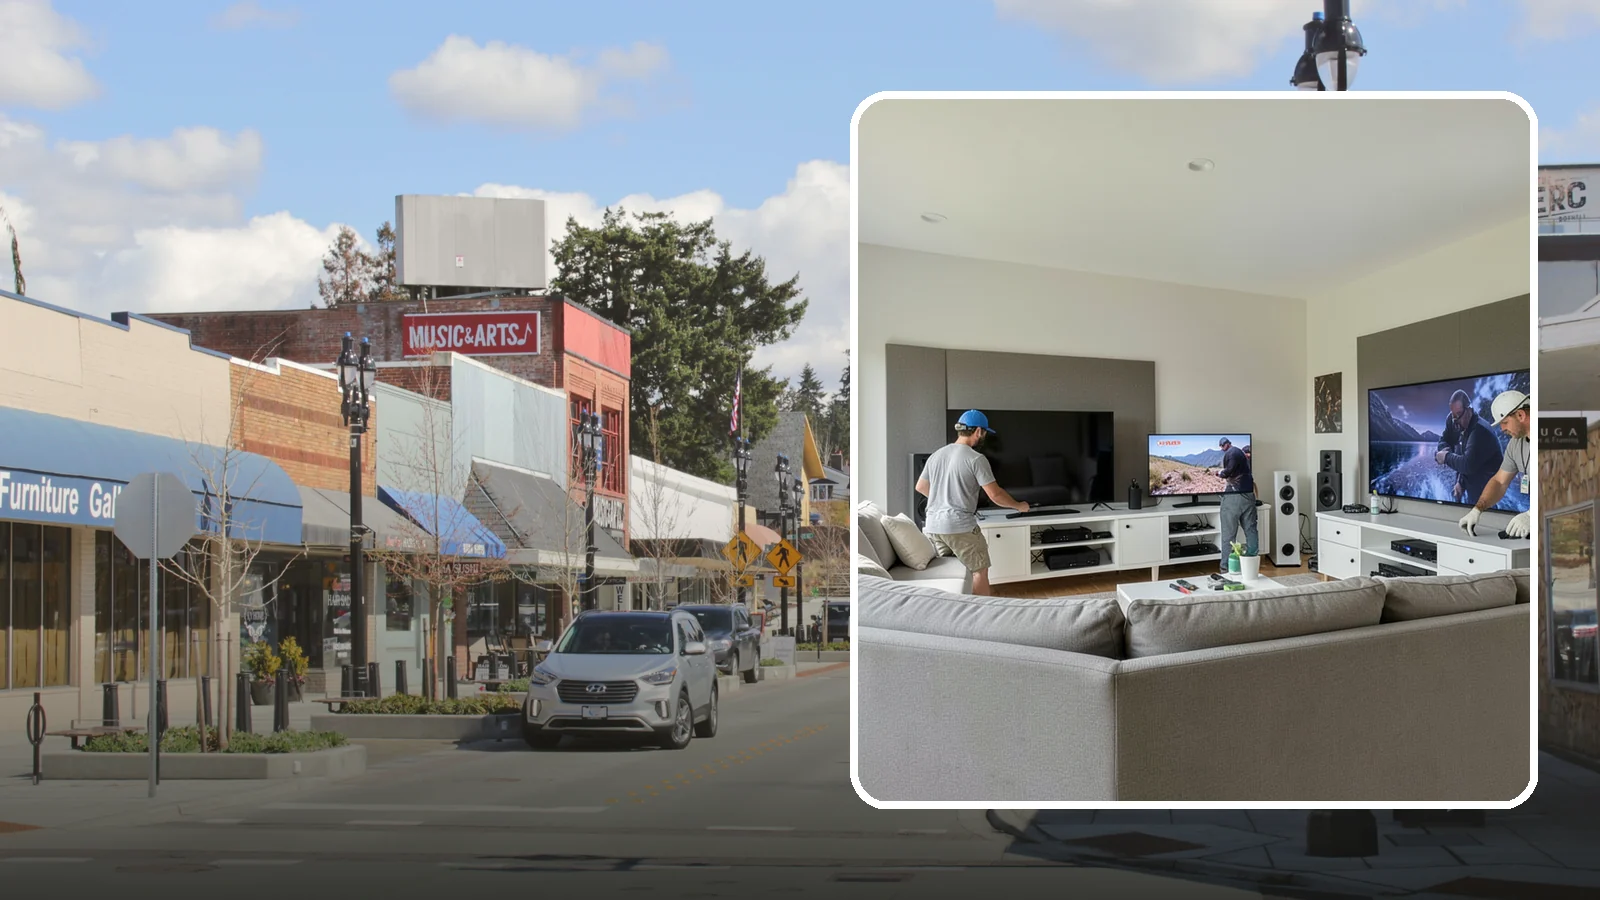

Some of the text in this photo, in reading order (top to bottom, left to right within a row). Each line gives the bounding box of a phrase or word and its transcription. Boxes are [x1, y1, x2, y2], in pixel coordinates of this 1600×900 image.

[409, 322, 519, 349] MUSIC&ARTS
[0, 471, 121, 519] Furniture Gal
